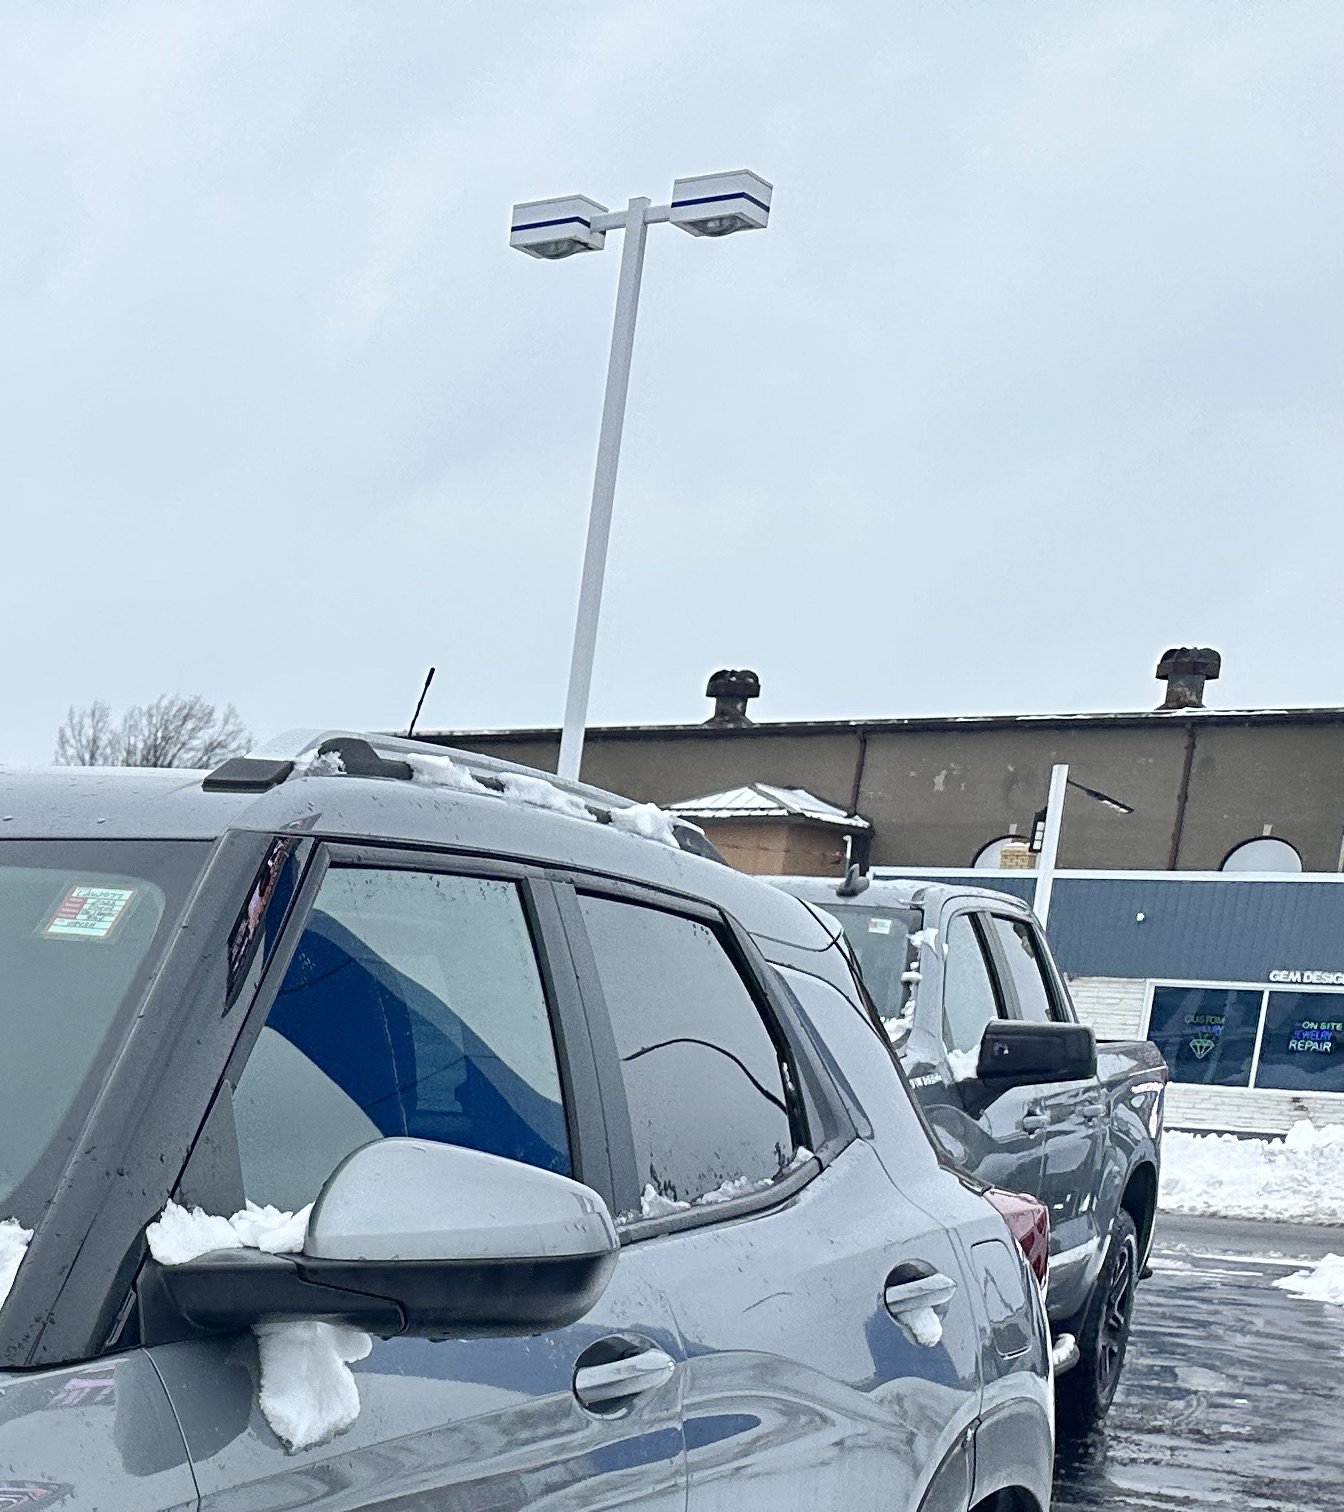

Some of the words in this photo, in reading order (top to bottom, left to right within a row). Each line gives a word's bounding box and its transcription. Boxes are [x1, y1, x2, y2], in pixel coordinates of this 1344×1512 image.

[1269, 970, 1302, 982] GEM
[1303, 971, 1344, 984] DESIG
[1320, 1021, 1343, 1032] SITE
[1288, 1039, 1332, 1053] REPAIR
